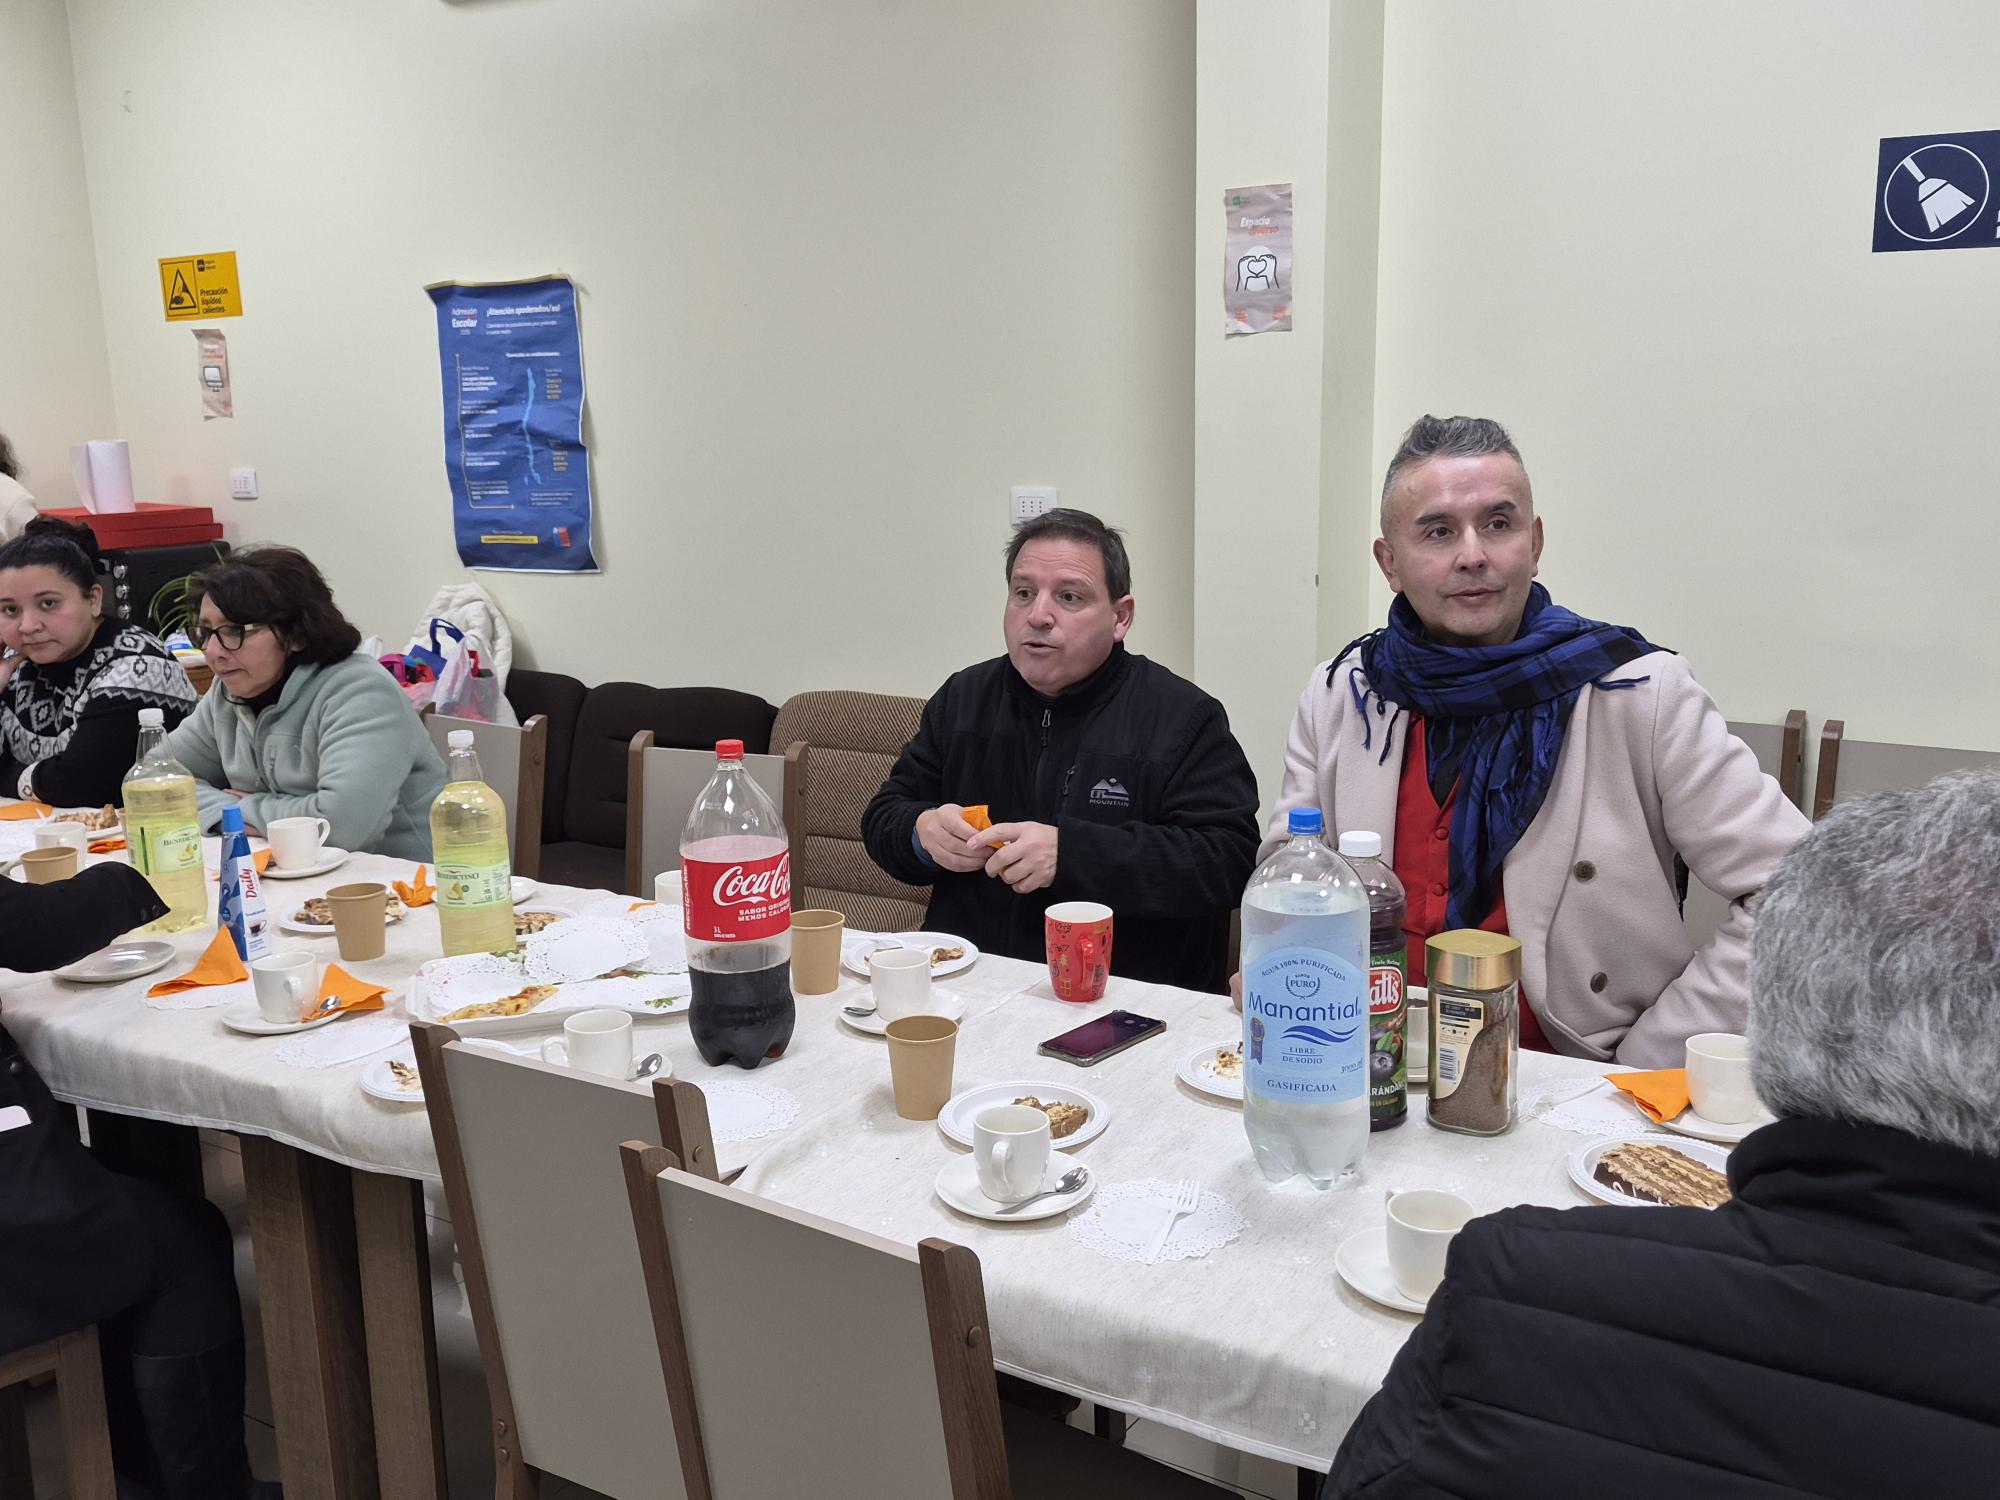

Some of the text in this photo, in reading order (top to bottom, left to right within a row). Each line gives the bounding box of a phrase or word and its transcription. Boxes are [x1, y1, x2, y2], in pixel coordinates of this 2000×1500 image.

[1240, 216, 1271, 229] Espacio
[200, 287, 228, 296] Precaución
[452, 318, 477, 328] Escolar
[240, 868, 257, 899] Daily
[738, 912, 767, 921] MENOS
[739, 906, 767, 916] SABOR
[1261, 959, 1346, 982] AGUA 100% PURIFICADA
[1290, 980, 1316, 988] PURO
[1248, 991, 1359, 1021] Manantial
[1267, 1079, 1337, 1092] GASIFICADA
